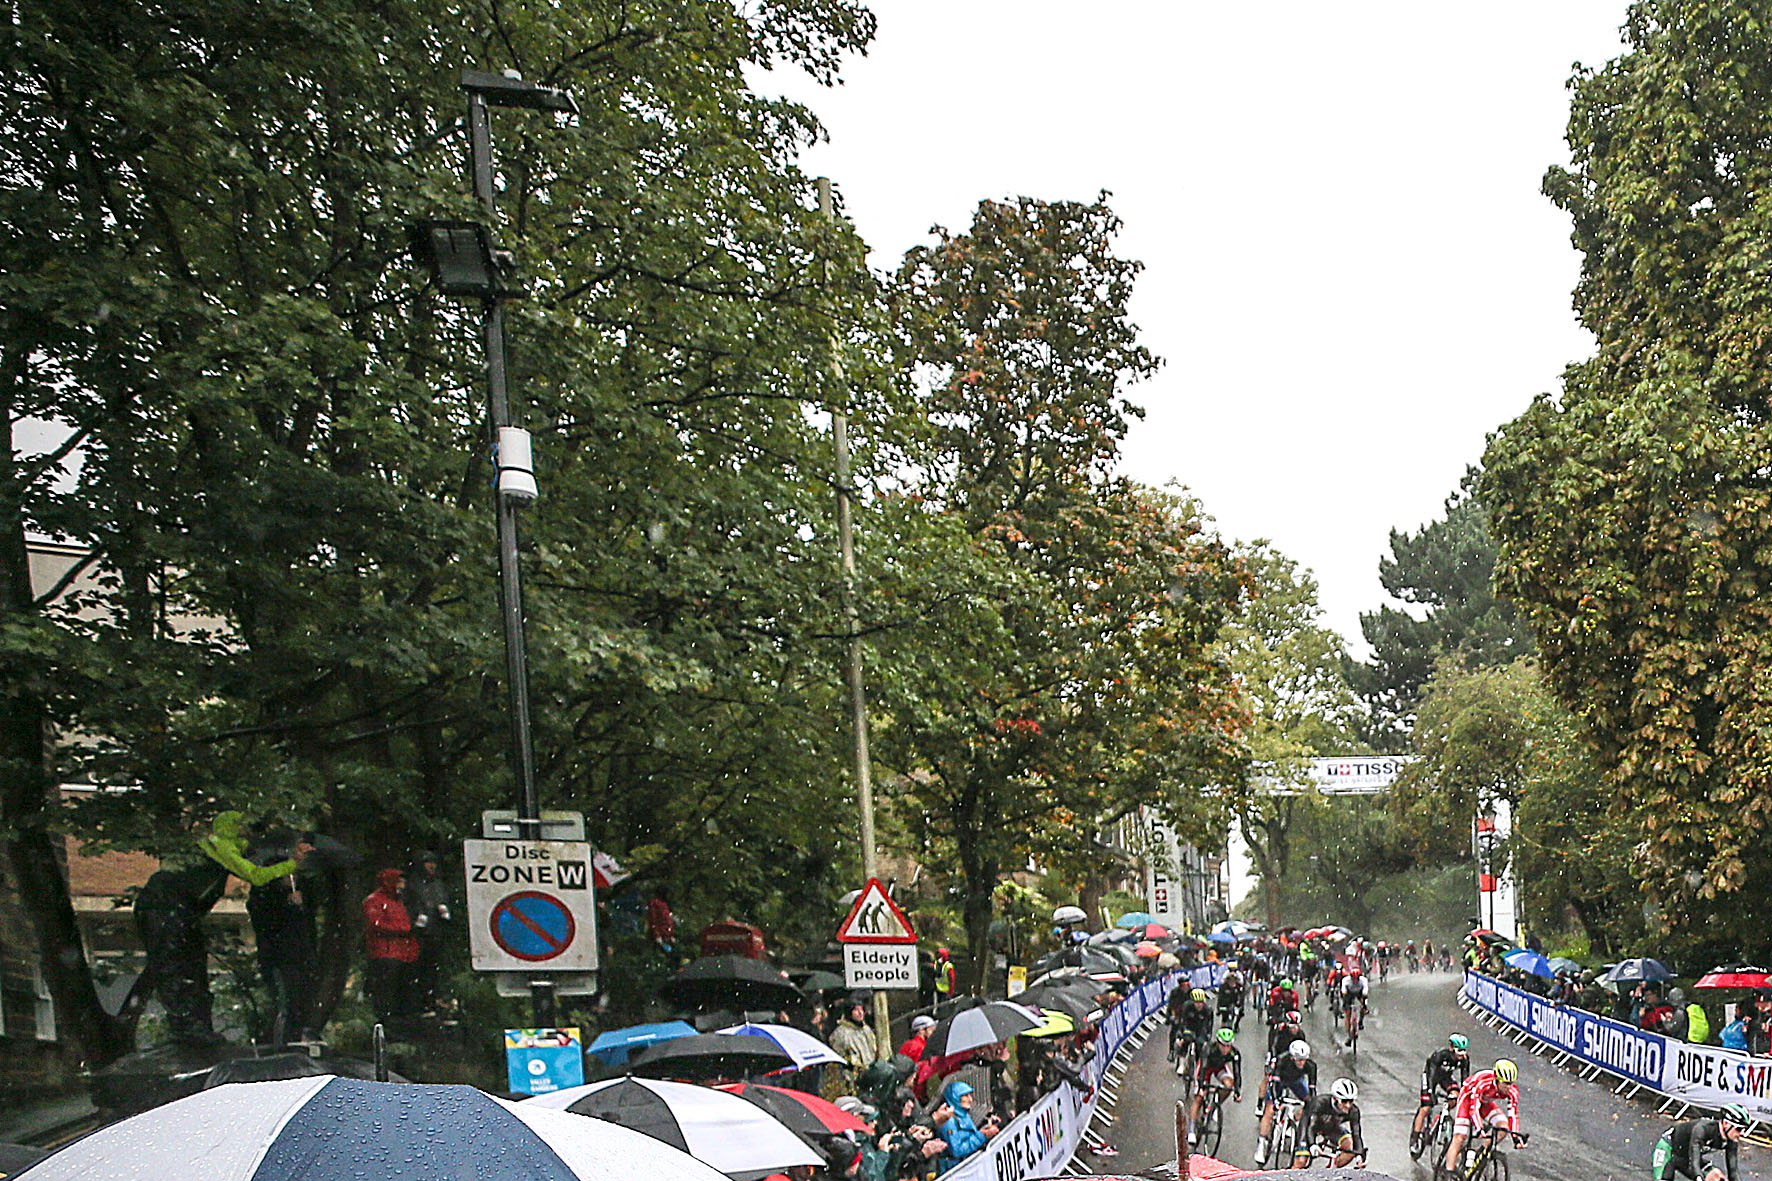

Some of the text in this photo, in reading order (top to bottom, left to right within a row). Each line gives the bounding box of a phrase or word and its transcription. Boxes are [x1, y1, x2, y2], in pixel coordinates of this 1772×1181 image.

[1353, 763, 1404, 776] TISSO
[505, 845, 550, 860] Disc
[471, 864, 584, 885] ZONE W
[851, 950, 910, 966] Elderly
[854, 967, 910, 982] people
[1531, 1001, 1577, 1049] SHIMANO
[1583, 1020, 1661, 1083] SHIMANO
[1677, 1050, 1714, 1087] RIDE
[1718, 1058, 1730, 1092] &
[1024, 1125, 1037, 1171] &
[1035, 1097, 1064, 1161] SMILE
